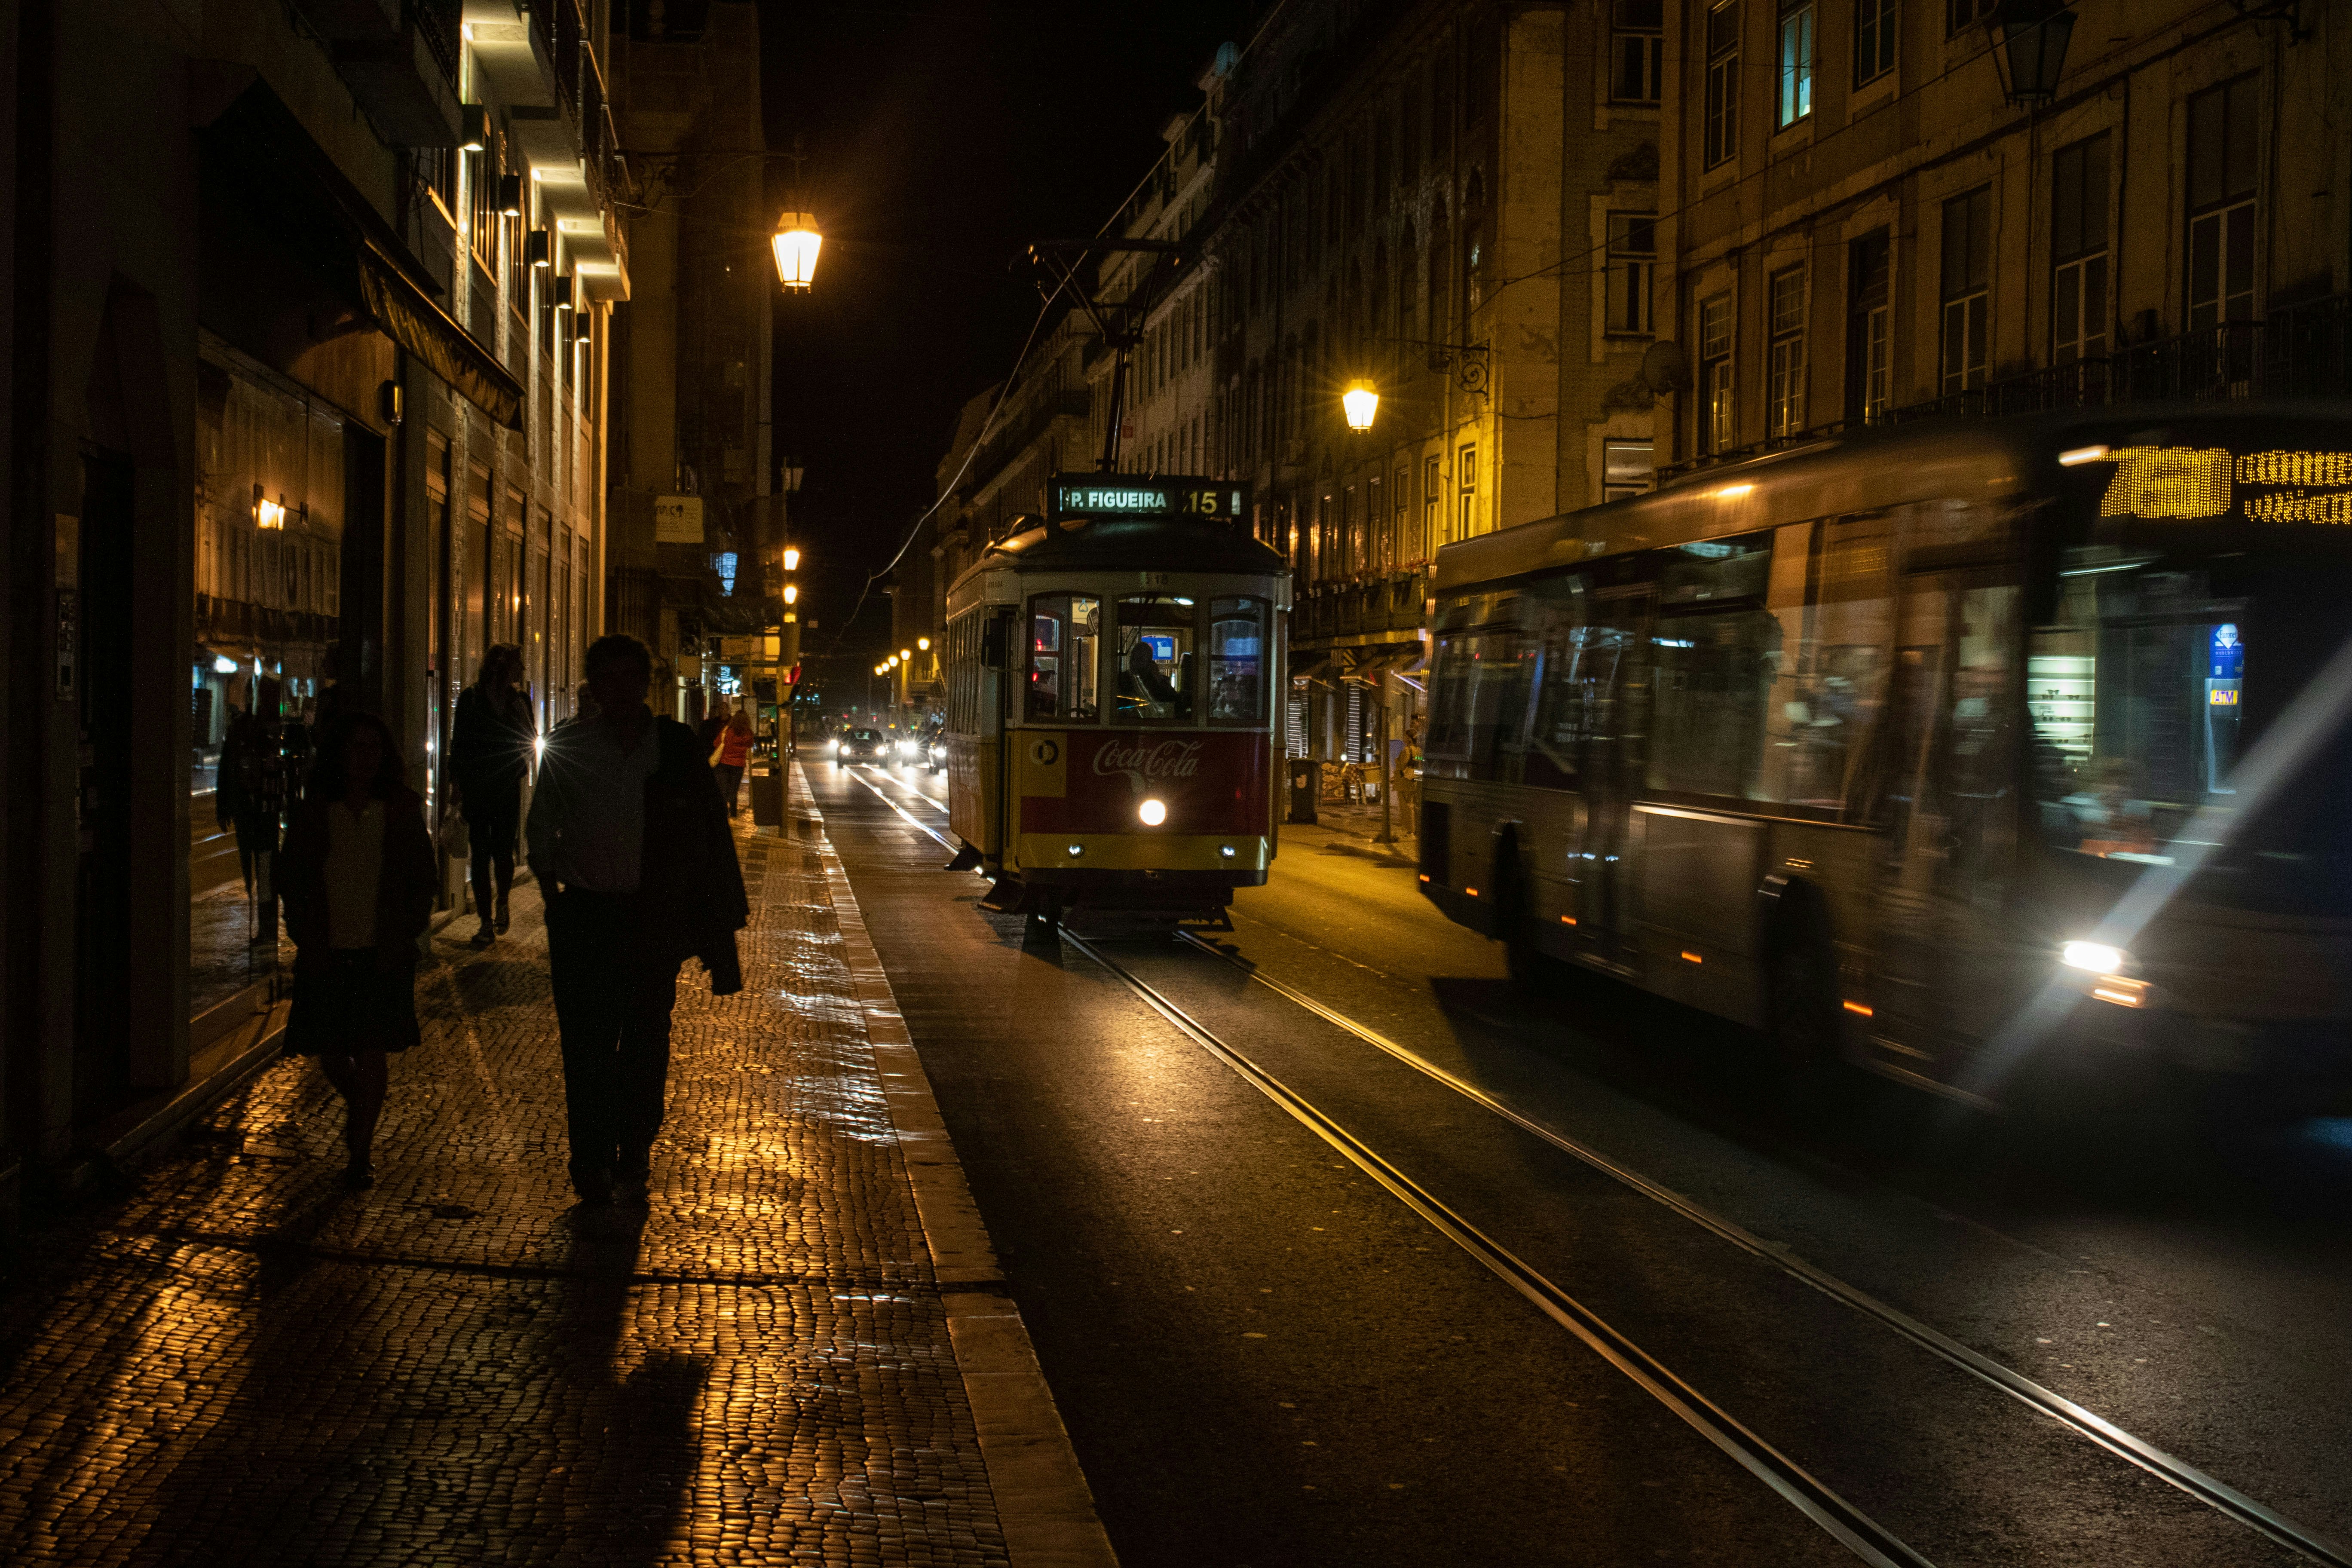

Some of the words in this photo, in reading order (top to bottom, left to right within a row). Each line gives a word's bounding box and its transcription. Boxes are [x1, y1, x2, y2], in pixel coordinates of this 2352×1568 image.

[1072, 492, 1083, 508] P.
[1089, 492, 1167, 508] FIGUEIRA
[1189, 491, 1217, 514] 15
[2215, 691, 2234, 704] ATM
[1093, 738, 1204, 780] Coca-Cola
